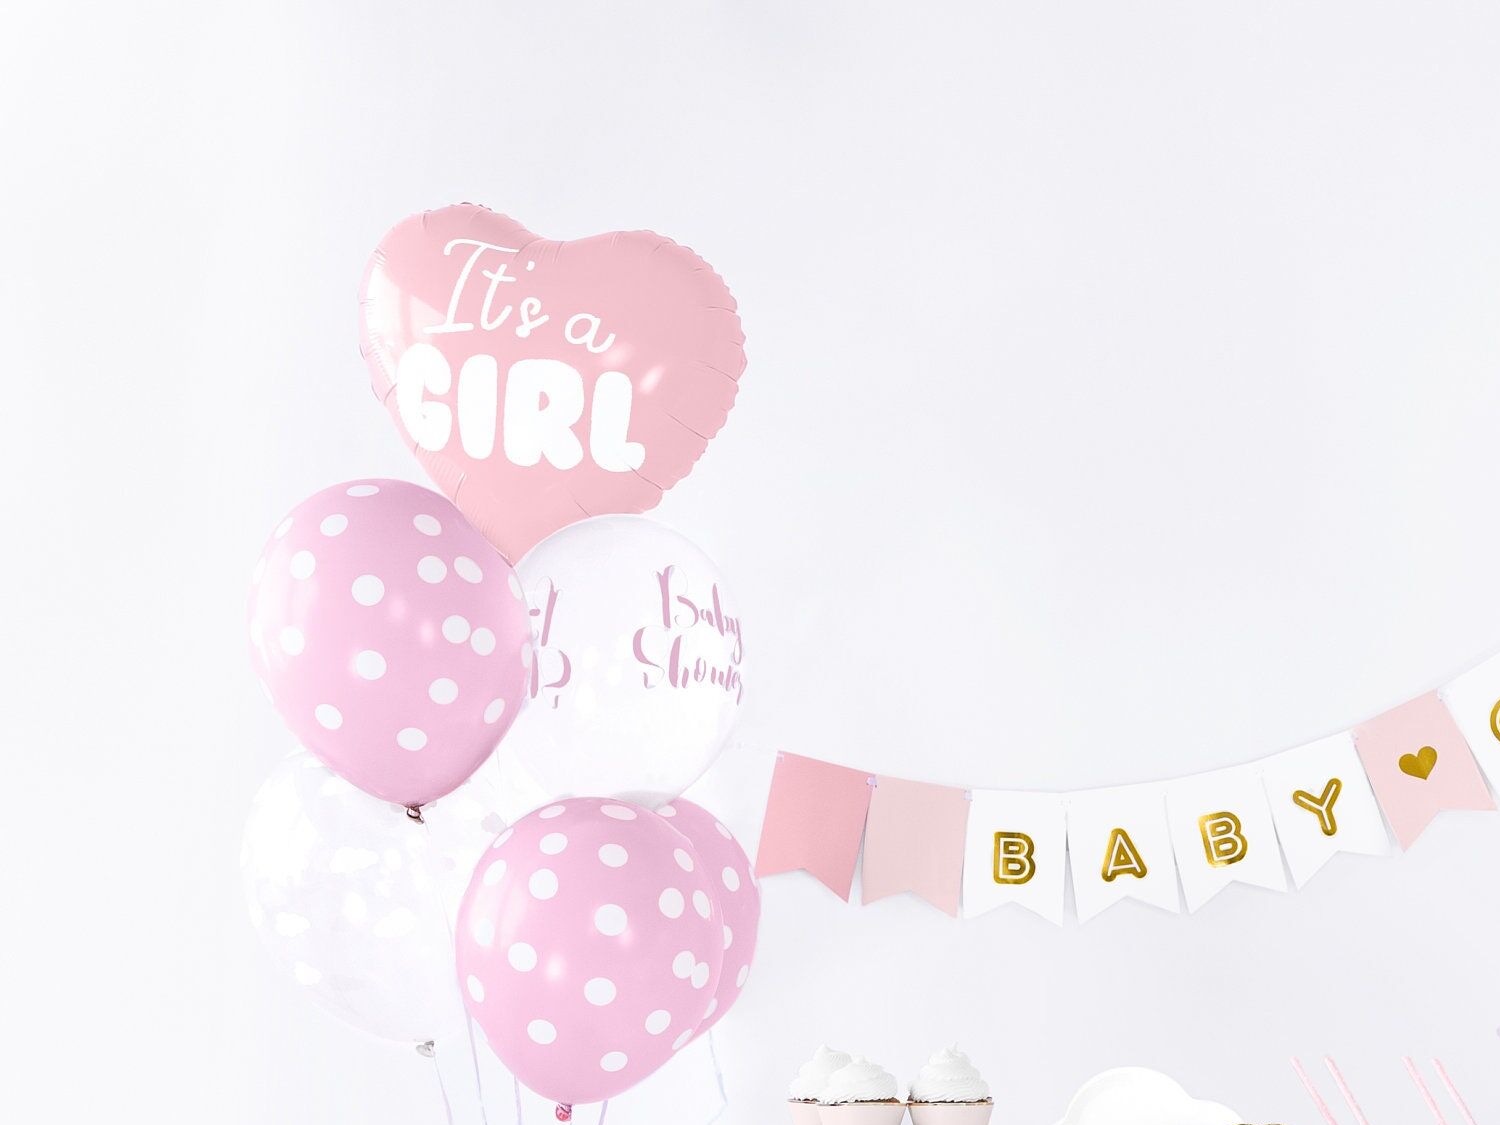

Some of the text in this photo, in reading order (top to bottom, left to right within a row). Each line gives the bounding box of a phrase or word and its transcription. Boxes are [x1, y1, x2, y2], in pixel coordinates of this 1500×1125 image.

[423, 237, 616, 354] It's a
[395, 342, 646, 473] GIRL
[992, 777, 1344, 885] BABY
